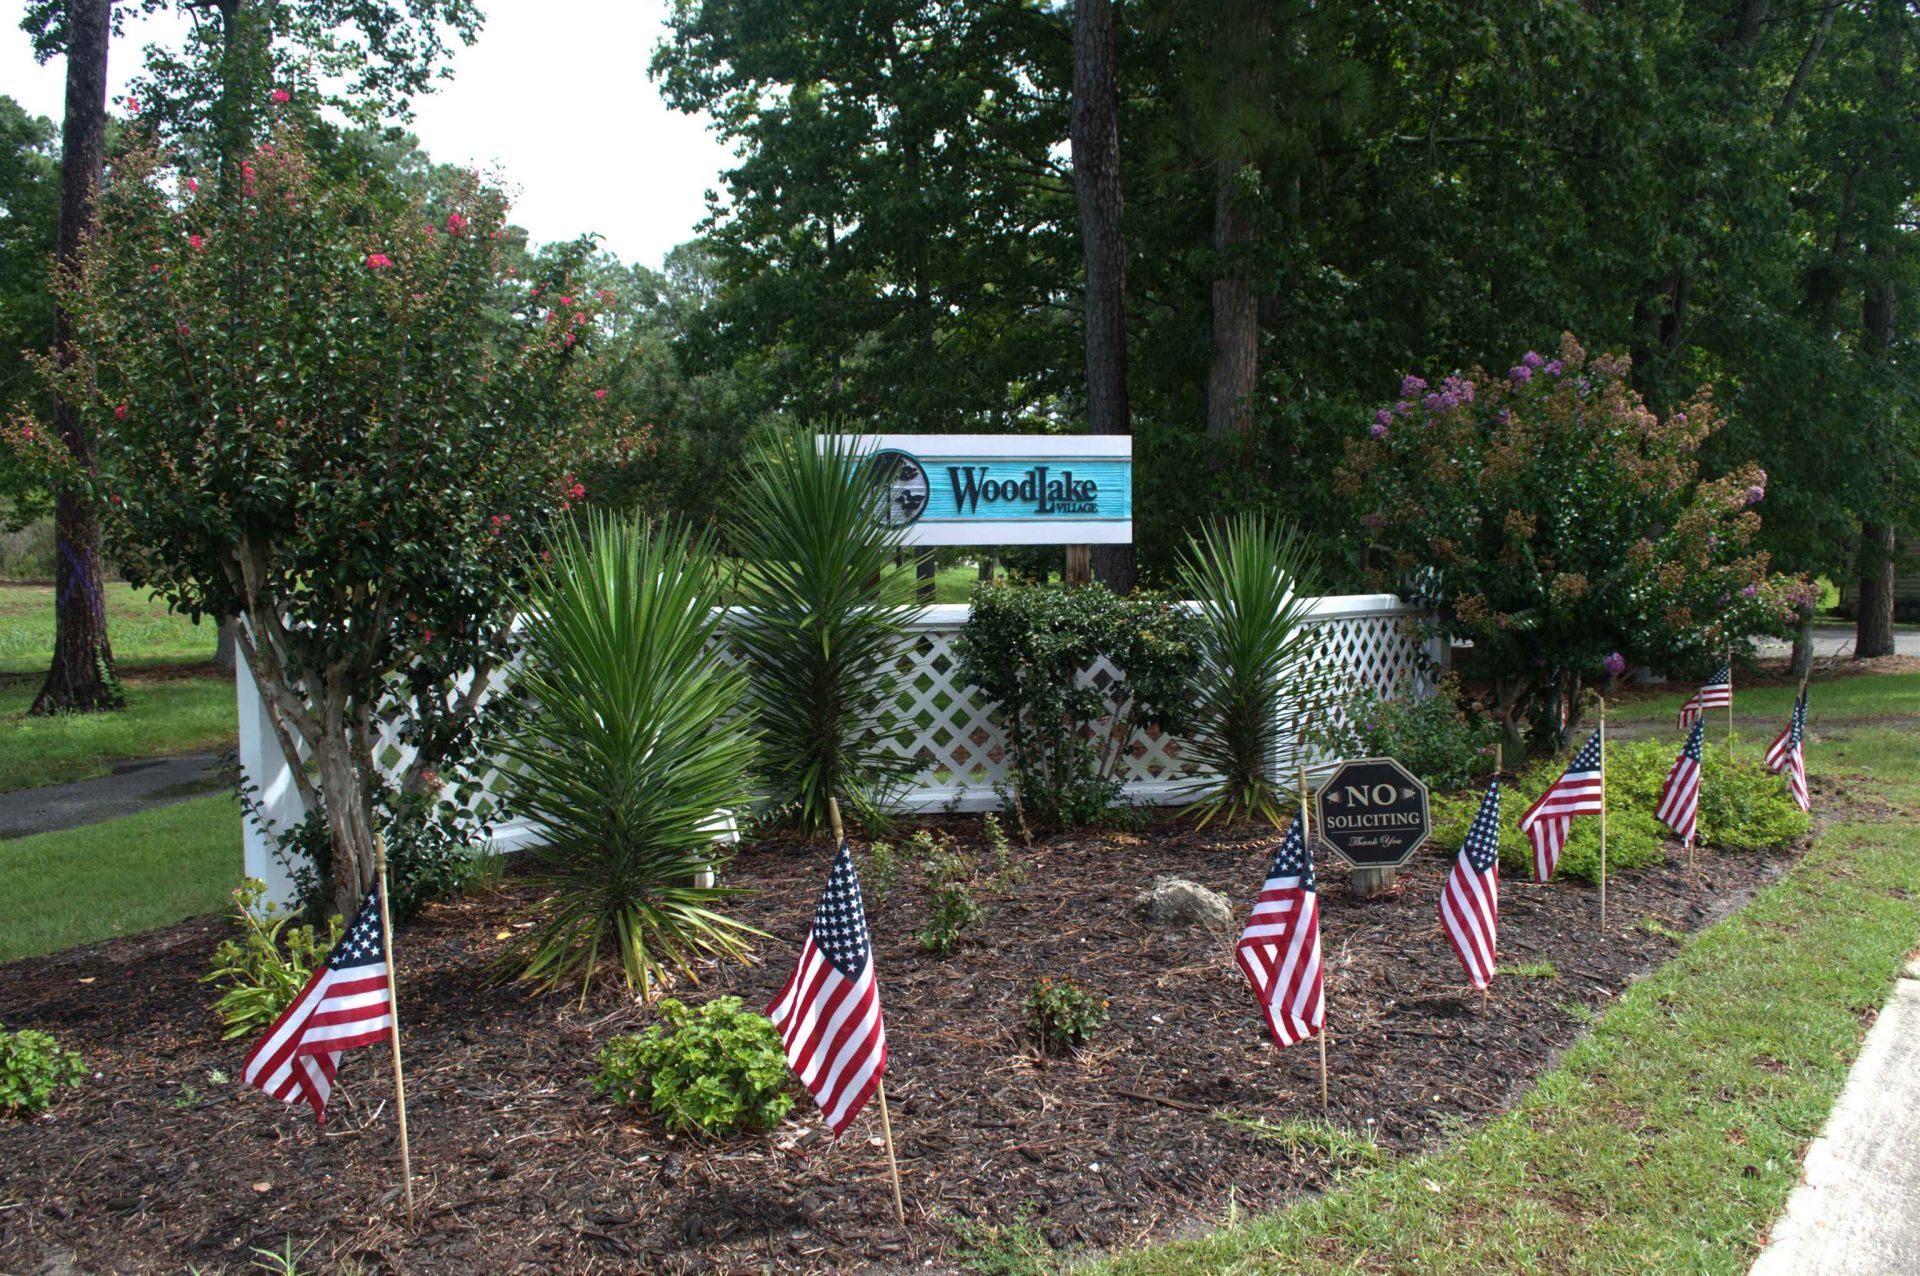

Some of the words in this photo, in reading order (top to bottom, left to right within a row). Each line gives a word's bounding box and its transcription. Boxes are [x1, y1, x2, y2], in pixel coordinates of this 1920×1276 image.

[947, 466, 1098, 514] WoodLake
[1055, 502, 1098, 514] VILLAGE
[1344, 784, 1397, 807] NO
[1327, 812, 1420, 829] SOLICITING
[1348, 836, 1378, 847] Thank
[1380, 834, 1402, 848] You
